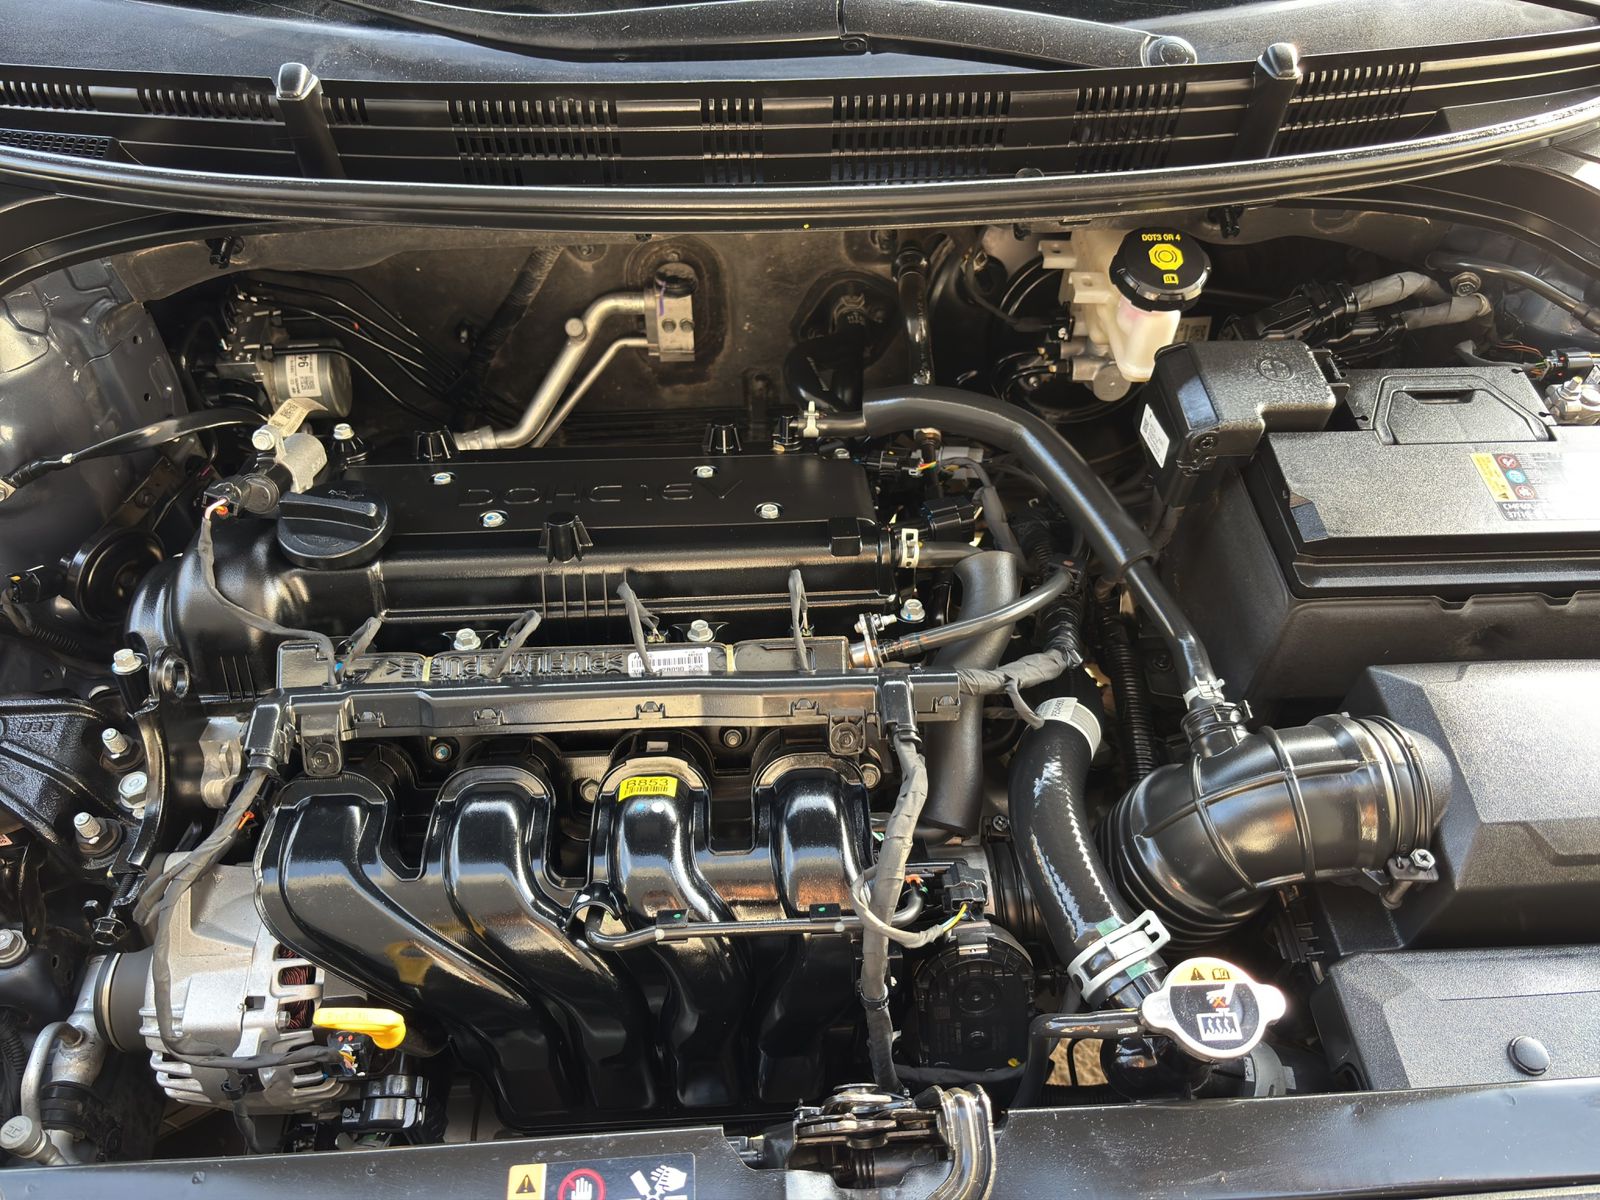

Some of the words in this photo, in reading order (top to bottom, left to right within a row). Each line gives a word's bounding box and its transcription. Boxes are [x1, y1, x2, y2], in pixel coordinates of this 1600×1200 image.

[1141, 233, 1161, 241] DOT3
[1163, 233, 1174, 241] OR
[1175, 233, 1181, 241] 4
[448, 484, 623, 507] DOHC
[639, 478, 743, 502] 16V
